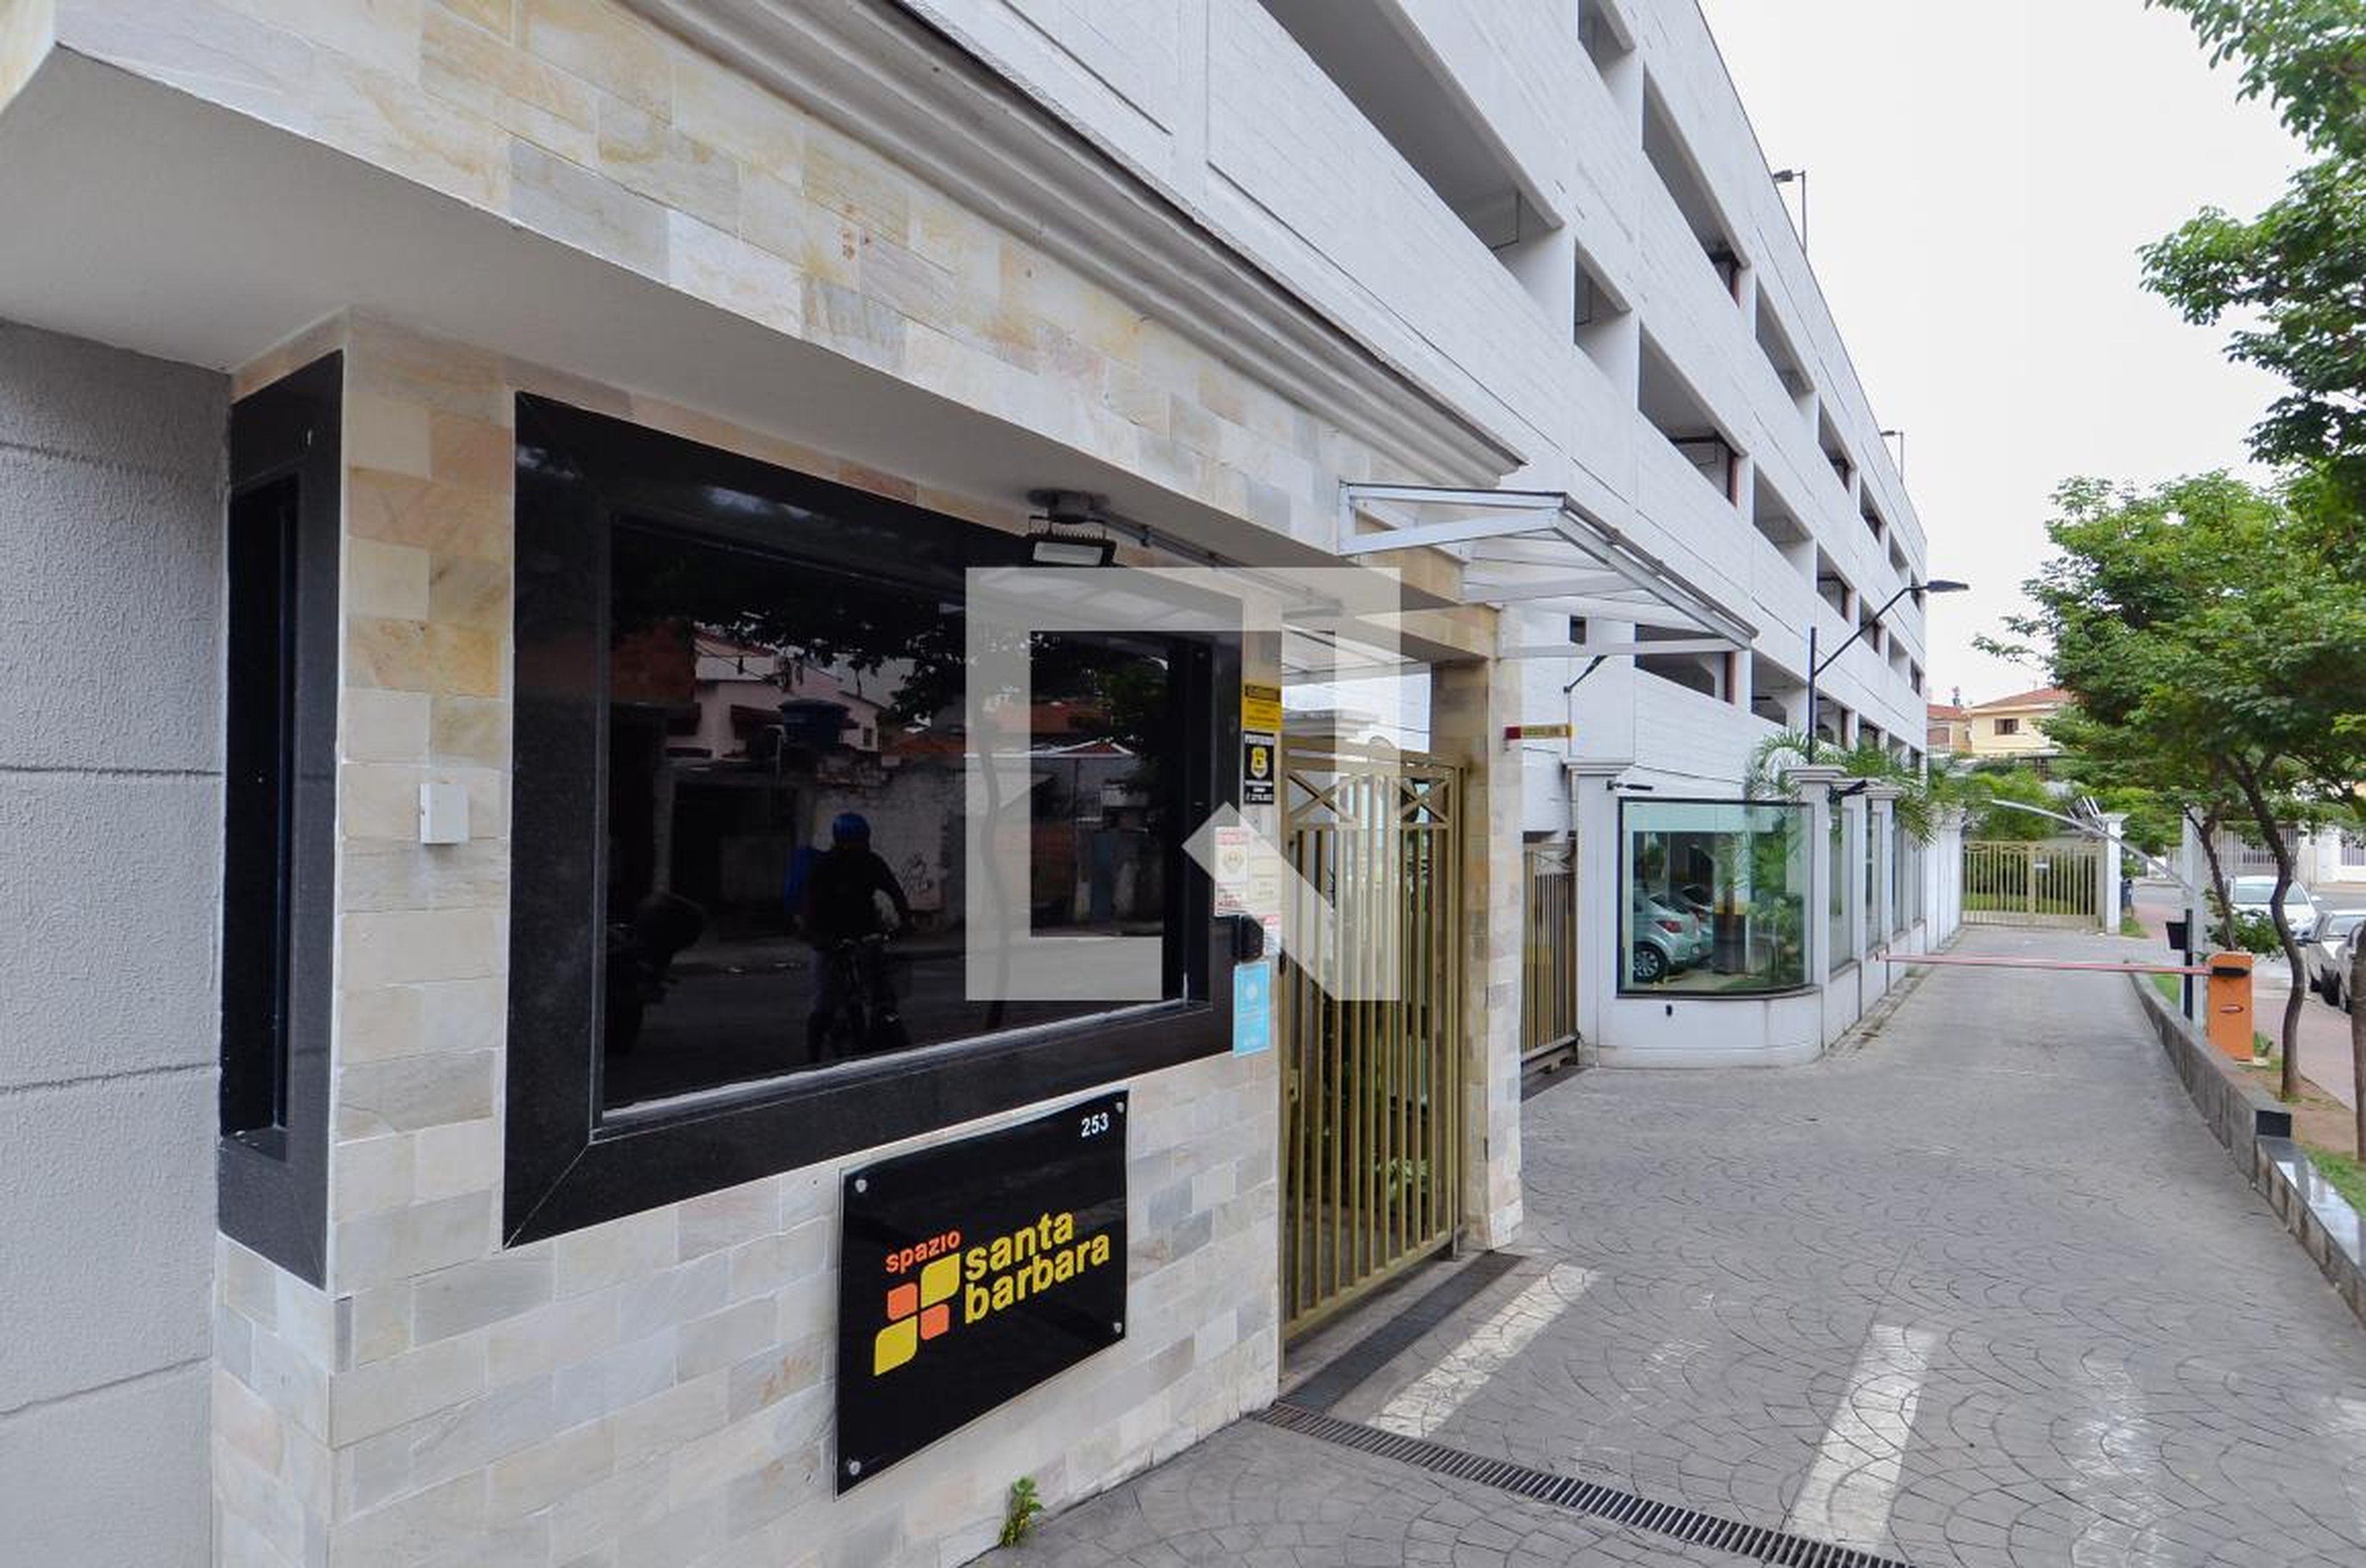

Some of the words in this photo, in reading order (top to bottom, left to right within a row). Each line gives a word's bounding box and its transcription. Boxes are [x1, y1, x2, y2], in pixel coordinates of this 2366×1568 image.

[1081, 1112, 1108, 1137] 253
[885, 1231, 961, 1273] spazio
[965, 1212, 1074, 1281] santa
[965, 1234, 1110, 1324] barbara
